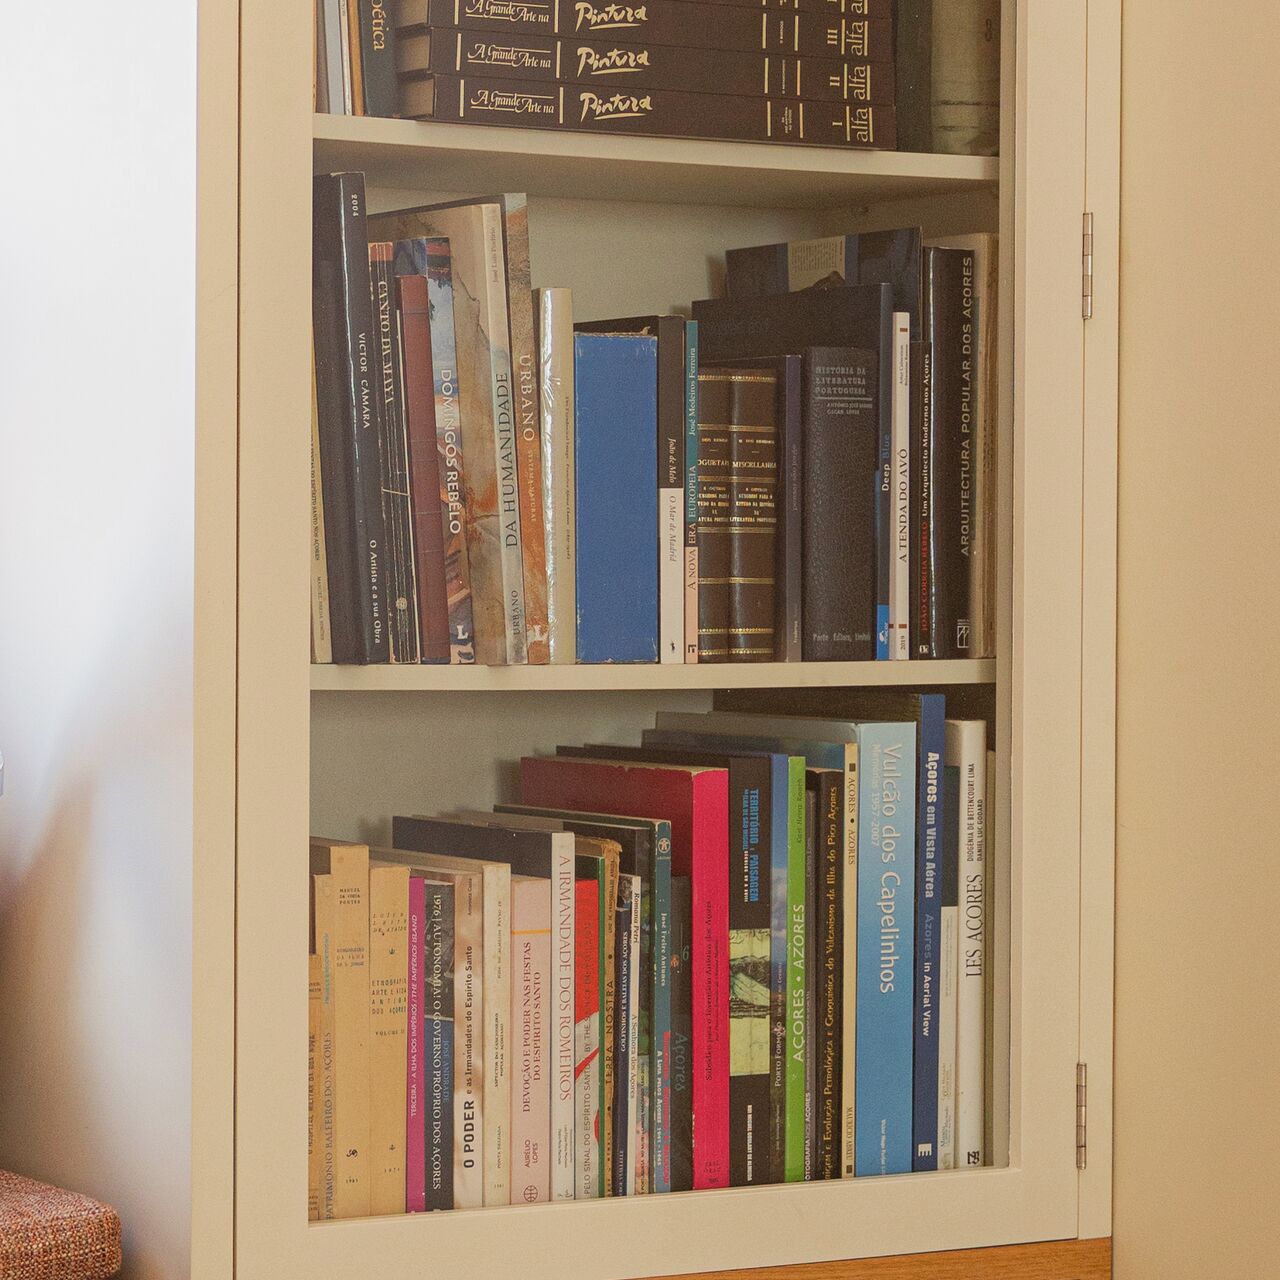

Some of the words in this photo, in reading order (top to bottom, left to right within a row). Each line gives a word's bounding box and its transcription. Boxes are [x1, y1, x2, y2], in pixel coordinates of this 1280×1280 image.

[351, 194, 359, 217] 2004
[962, 257, 972, 318] AÇORES
[358, 333, 368, 372] VICTOR
[963, 324, 971, 354] DOS
[688, 347, 696, 380] Ferreira
[519, 354, 535, 441] URBANO
[688, 382, 696, 418] Medeiros
[961, 360, 971, 433] POPULAR
[441, 369, 457, 467] DOMINGOS
[688, 420, 696, 436] José
[496, 372, 516, 511] HUMANIDADE
[898, 448, 908, 475] AVÔ
[447, 472, 462, 534] REBÊLO
[688, 466, 696, 518] EUROPEIA
[900, 481, 908, 502] DO
[961, 439, 970, 556] ARQUITECTURA
[506, 520, 518, 548] DA
[688, 523, 696, 544] ERA
[899, 505, 908, 550] TENDA
[688, 549, 696, 577] NOVA
[899, 554, 908, 563] A
[688, 581, 696, 591] A
[882, 744, 902, 816] Vulcão
[925, 752, 940, 803] Açores
[927, 806, 935, 826] em
[560, 856, 570, 866] A
[882, 825, 896, 864] dos
[926, 828, 937, 858] Vista
[925, 861, 936, 898] Aérea
[432, 895, 442, 917] 1976
[560, 872, 571, 973] IRMANDADE
[966, 875, 984, 944] AÇORES
[793, 904, 805, 969] AZORES
[877, 872, 900, 994] Capelinhos
[432, 924, 442, 998] AUTONOMIA!
[966, 948, 982, 978] LES
[434, 1001, 441, 1009] O
[560, 977, 571, 1015] DOS
[432, 1012, 442, 1068] GOVERNO
[794, 988, 805, 1062] AÇORES
[534, 1064, 541, 1081] DO
[560, 1017, 571, 1101] ROMEIROS
[432, 1070, 443, 1119] PRÓPRIO
[523, 1060, 532, 1112] DEVOÇÃO
[432, 1122, 442, 1144] DOS
[464, 1100, 475, 1153] PODER
[432, 1146, 442, 1190] AÇORES
[464, 1160, 475, 1168] O
